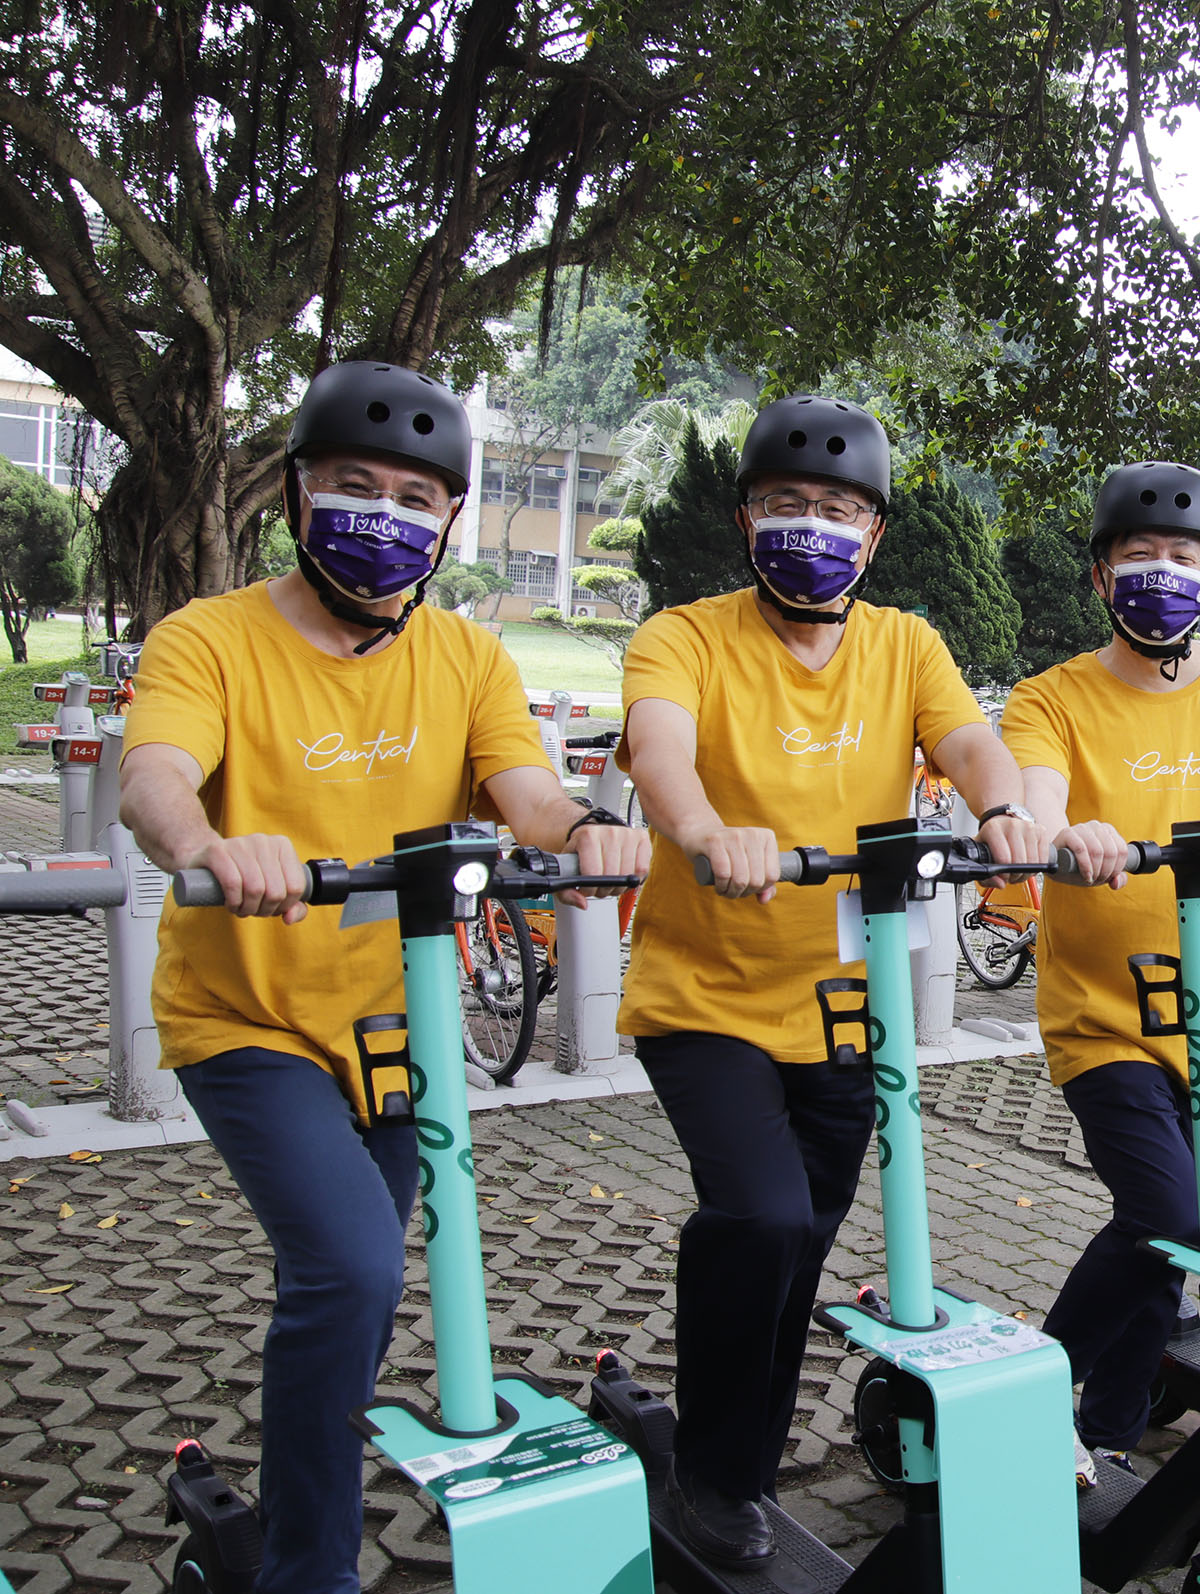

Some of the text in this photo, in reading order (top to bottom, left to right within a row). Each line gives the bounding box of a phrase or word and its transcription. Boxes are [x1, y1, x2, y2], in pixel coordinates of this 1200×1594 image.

[347, 513, 357, 533] I
[782, 530, 789, 548] I
[47, 691, 63, 699] 29-1
[90, 692, 107, 700] 29-2
[34, 729, 57, 738] 19-2
[73, 746, 97, 756] 14-1
[296, 725, 418, 775] Central
[585, 761, 602, 770] 12-1
[582, 1444, 627, 1464] oloo
